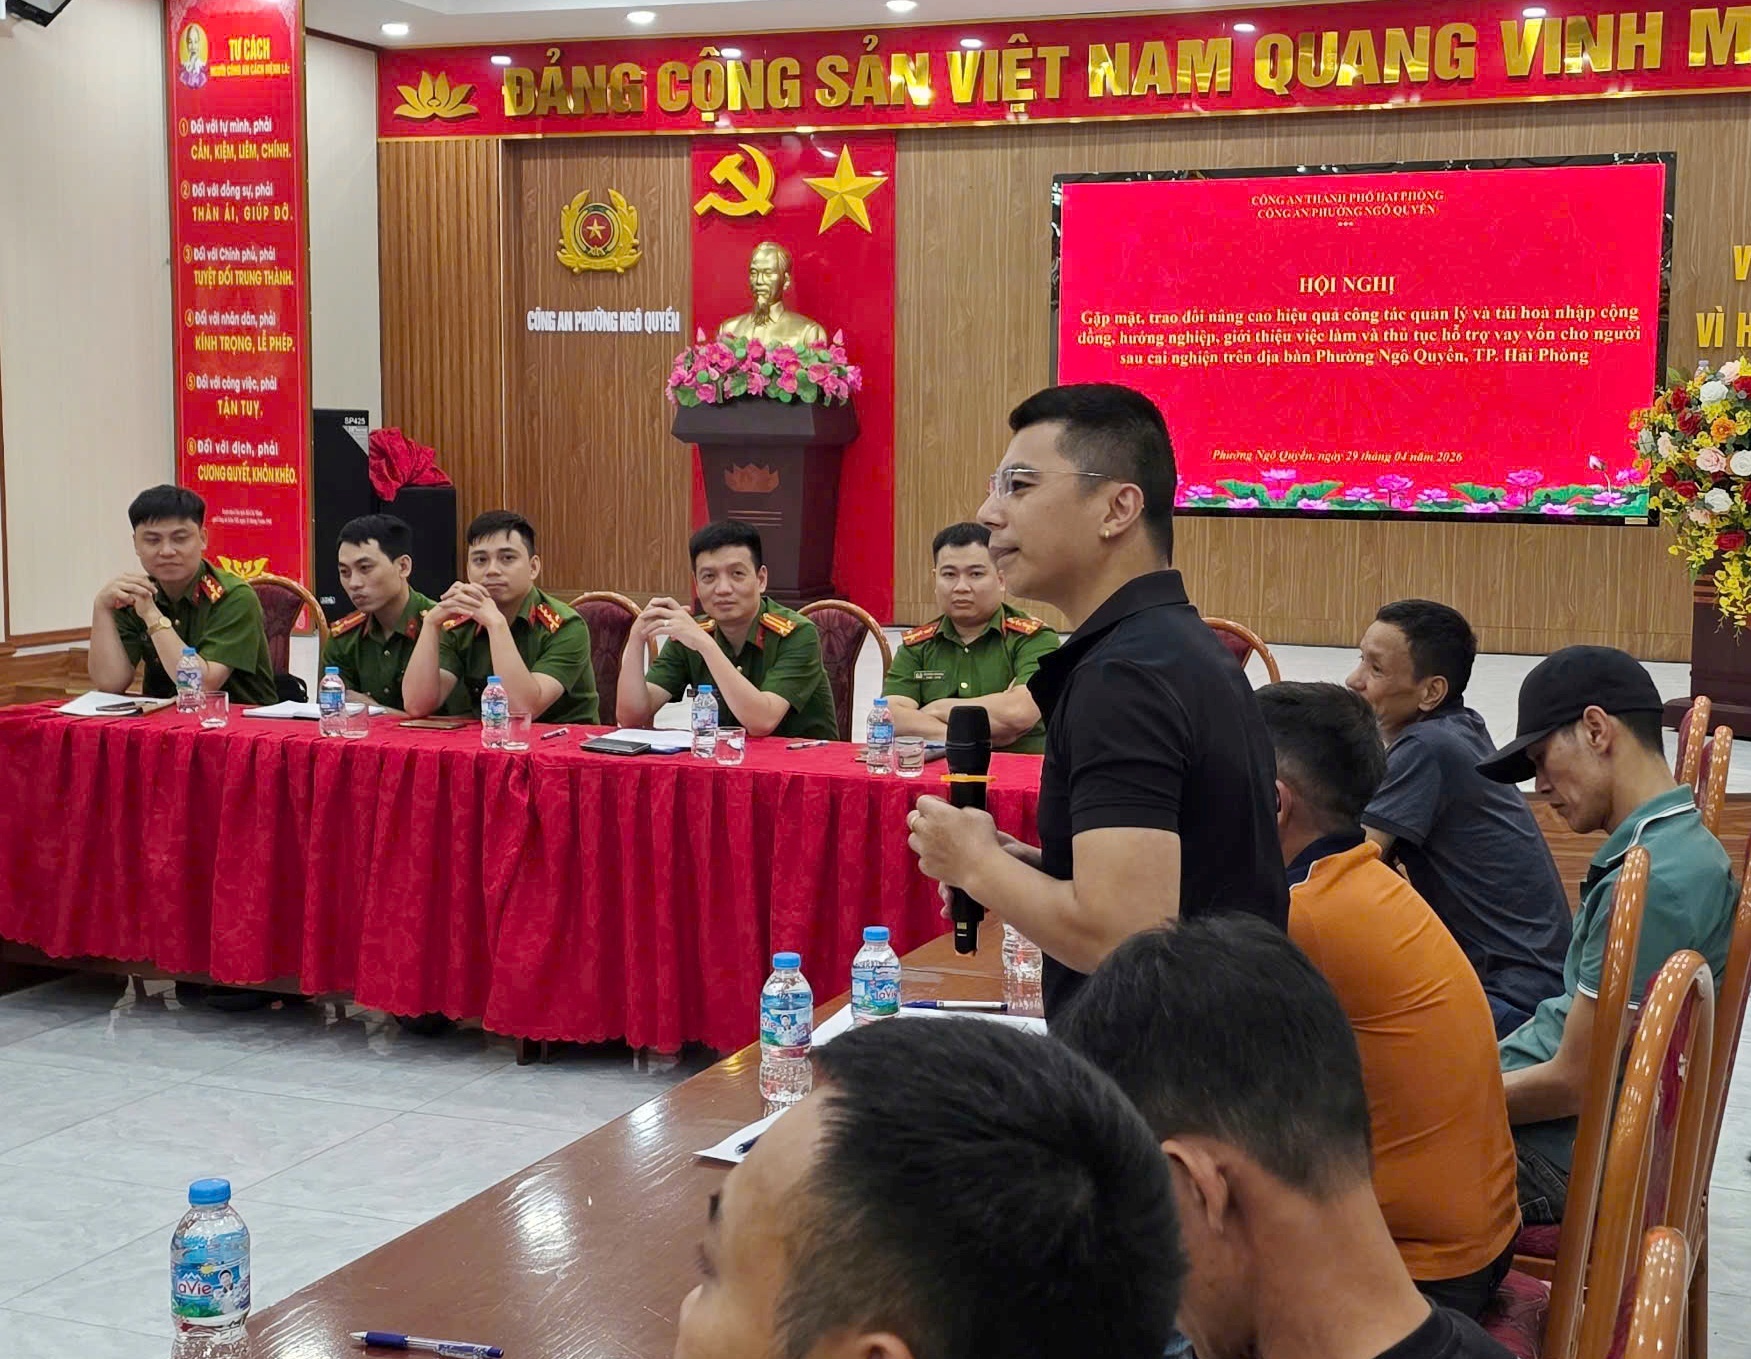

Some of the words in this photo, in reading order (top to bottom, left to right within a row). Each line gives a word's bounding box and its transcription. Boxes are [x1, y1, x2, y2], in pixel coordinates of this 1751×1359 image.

[228, 37, 242, 61] TƯ
[244, 34, 270, 60] CÁCH
[503, 47, 646, 116] ĐẢNG
[656, 47, 801, 122] CỘNG
[816, 34, 931, 111] SẢN
[946, 33, 1069, 113] VIỆT
[1088, 36, 1233, 97] NAM
[1254, 25, 1477, 95] QUANG
[1501, 11, 1664, 77] VINH
[190, 116, 204, 134] Đối
[206, 118, 218, 134] với
[220, 118, 228, 136] tự
[229, 118, 252, 135] mình,
[254, 116, 272, 134] phải
[191, 138, 212, 162] CẦN,
[214, 141, 236, 163] KIỆM,
[239, 140, 258, 162] LIÊM,
[261, 140, 292, 158] CHÍNH.
[192, 181, 206, 198] Đối
[207, 182, 219, 197] với
[220, 180, 240, 200] đồng
[242, 184, 254, 200] sự,
[255, 181, 273, 199] phải
[1251, 193, 1285, 206] CÔNG
[1287, 194, 1302, 204] AN
[1305, 192, 1347, 204] THÀNH
[1400, 188, 1444, 202] PHÒNG
[192, 202, 220, 221] THÂN
[224, 202, 238, 224] ÁI,
[244, 202, 270, 221] GIÚP
[274, 202, 293, 220] ĐỠ.
[1258, 206, 1291, 219] CÔNG
[1294, 208, 1309, 218] AN
[1312, 204, 1362, 218] PHƯỜNG
[1364, 204, 1391, 216] NGÔ
[194, 246, 206, 261] Đối
[207, 247, 218, 261] với
[220, 247, 240, 260] Chính
[242, 246, 258, 263] phủ,
[260, 246, 276, 263] phải
[194, 266, 216, 290] TUYỆT
[218, 264, 233, 285] ĐỐI
[235, 270, 262, 285] TRUNG
[264, 266, 294, 286] THÀNH.
[1300, 275, 1336, 296] HỘI
[1343, 276, 1396, 294] NGHỊ
[195, 309, 206, 326] Đối
[208, 310, 220, 326] với
[221, 310, 240, 326] nhân
[241, 311, 258, 328] dân,
[260, 310, 276, 328] phải
[527, 306, 558, 332] CÔNG
[558, 311, 573, 332] AN
[574, 306, 618, 332] PHƯỜNG
[620, 308, 642, 332] NGÔ
[644, 306, 680, 334] QUYỀN
[1080, 310, 1110, 327] Gặp
[1115, 311, 1145, 328] mặt,
[1150, 313, 1179, 324] trao
[1182, 307, 1205, 324] đổi
[1208, 310, 1244, 326] nâng
[1248, 312, 1272, 322] cao
[1276, 308, 1308, 324] hiệu
[1312, 308, 1340, 325] quả
[1344, 308, 1380, 324] công
[1384, 306, 1407, 320] tác
[1410, 308, 1449, 324] quản
[1454, 306, 1470, 323] lý
[1472, 306, 1491, 320] và
[1496, 306, 1516, 320] tái
[1520, 305, 1550, 320] hoà
[1555, 304, 1596, 322] nhập
[1600, 304, 1639, 322] cộng
[1696, 305, 1724, 348] VÌ
[195, 332, 218, 351] KÍNH
[219, 336, 255, 356] TRỌNG,
[258, 330, 266, 352] LỄ
[270, 332, 296, 352] PHÉP.
[1077, 326, 1116, 347] đồng,
[1120, 330, 1165, 347] hướng
[1168, 330, 1220, 348] nghiệp,
[1224, 329, 1251, 346] giới
[1255, 329, 1292, 346] thiệu
[1296, 330, 1325, 345] việc
[1329, 328, 1357, 342] làm
[1362, 328, 1380, 342] và
[1383, 326, 1408, 342] thủ
[1413, 328, 1437, 344] tục
[1442, 322, 1461, 342] hỗ
[1465, 329, 1490, 344] trợ
[1494, 330, 1520, 344] vay
[1526, 322, 1556, 340] vốn
[1560, 327, 1589, 340] cho
[1594, 326, 1640, 343] người
[1120, 353, 1144, 364] sau
[1147, 350, 1167, 364] cai
[1170, 350, 1218, 367] nghiện
[1223, 350, 1252, 364] trên
[1256, 350, 1279, 366] địa
[1284, 350, 1310, 364] bàn
[1316, 348, 1374, 366] Phường
[1378, 348, 1409, 364] Ngô
[1414, 347, 1468, 366] Quyền,
[1472, 348, 1498, 362] TP.
[1504, 347, 1533, 362] Hải
[1538, 347, 1589, 364] Phòng
[196, 373, 208, 388] Đối
[210, 374, 220, 389] với
[222, 376, 240, 394] công
[242, 376, 259, 393] việc,
[260, 375, 277, 392] phải
[218, 396, 238, 419] TẬN
[198, 438, 212, 454] Đối
[215, 439, 228, 454] với
[232, 440, 254, 458] dịch,
[258, 440, 278, 458] phải
[1212, 448, 1253, 462] Phường
[1256, 449, 1278, 462] Ngô
[1317, 451, 1344, 464] ngày
[1346, 450, 1358, 462] 29
[1360, 450, 1392, 463] tháng
[1394, 451, 1408, 462] 04
[1410, 450, 1434, 462] năm
[1436, 451, 1463, 462] 2026
[198, 464, 226, 482] CƯƠNG
[227, 460, 252, 484] QUYẾT,
[252, 463, 274, 482] KHÔN
[276, 464, 297, 484] KHÉO.
